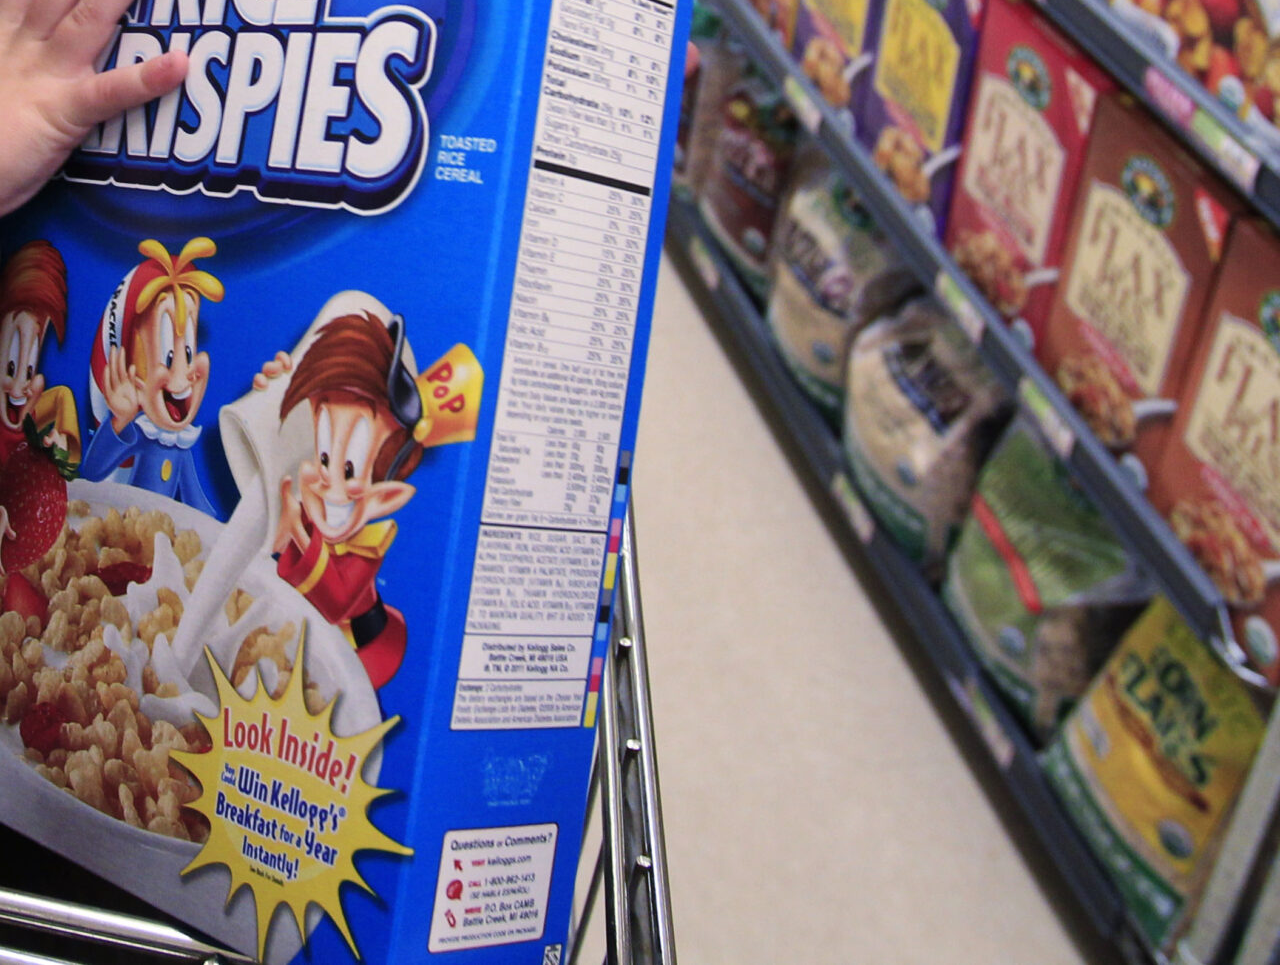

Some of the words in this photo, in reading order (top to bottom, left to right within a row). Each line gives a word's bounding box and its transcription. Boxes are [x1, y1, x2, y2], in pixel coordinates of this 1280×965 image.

[81, 20, 420, 179] RISPIES
[437, 151, 466, 167] RICE
[440, 135, 497, 153] TOASTED
[434, 166, 484, 185] CEREAL
[223, 707, 274, 756] Look
[277, 718, 357, 794] Inside!
[238, 766, 268, 803] Win
[270, 780, 339, 832] Kellogg's
[215, 791, 278, 841] Breakfast
[279, 824, 295, 845] for
[295, 836, 302, 849] a
[304, 830, 338, 866] Year
[450, 836, 495, 851] Questions
[504, 831, 553, 846] Comments?
[242, 835, 299, 880] Instantly!
